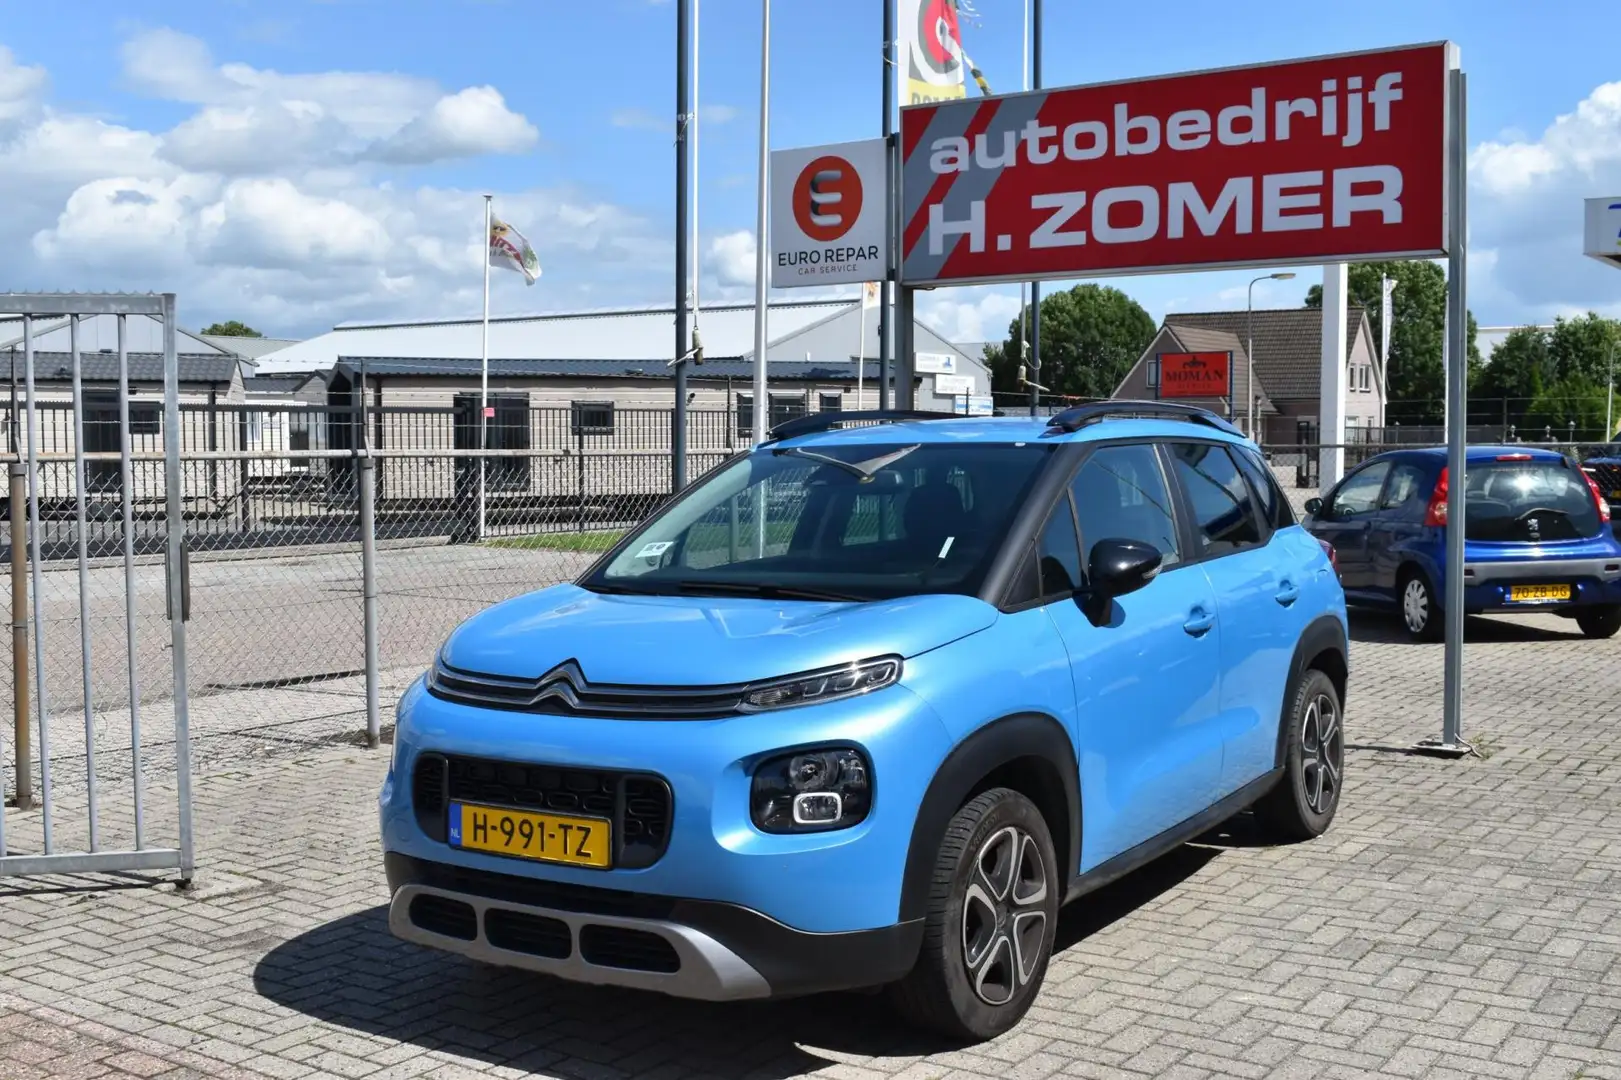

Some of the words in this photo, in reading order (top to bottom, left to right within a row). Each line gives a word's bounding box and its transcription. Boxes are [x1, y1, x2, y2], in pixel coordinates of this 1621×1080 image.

[929, 72, 1403, 175] autobedrijf
[928, 200, 1012, 255] H.
[1029, 164, 1403, 249] ZOMER
[778, 250, 821, 267] EURO
[825, 245, 878, 263] REPAR
[798, 266, 816, 276] CAR
[820, 264, 857, 274] SERVICE
[450, 827, 461, 839] NL
[473, 812, 592, 858] H-991-TZ
